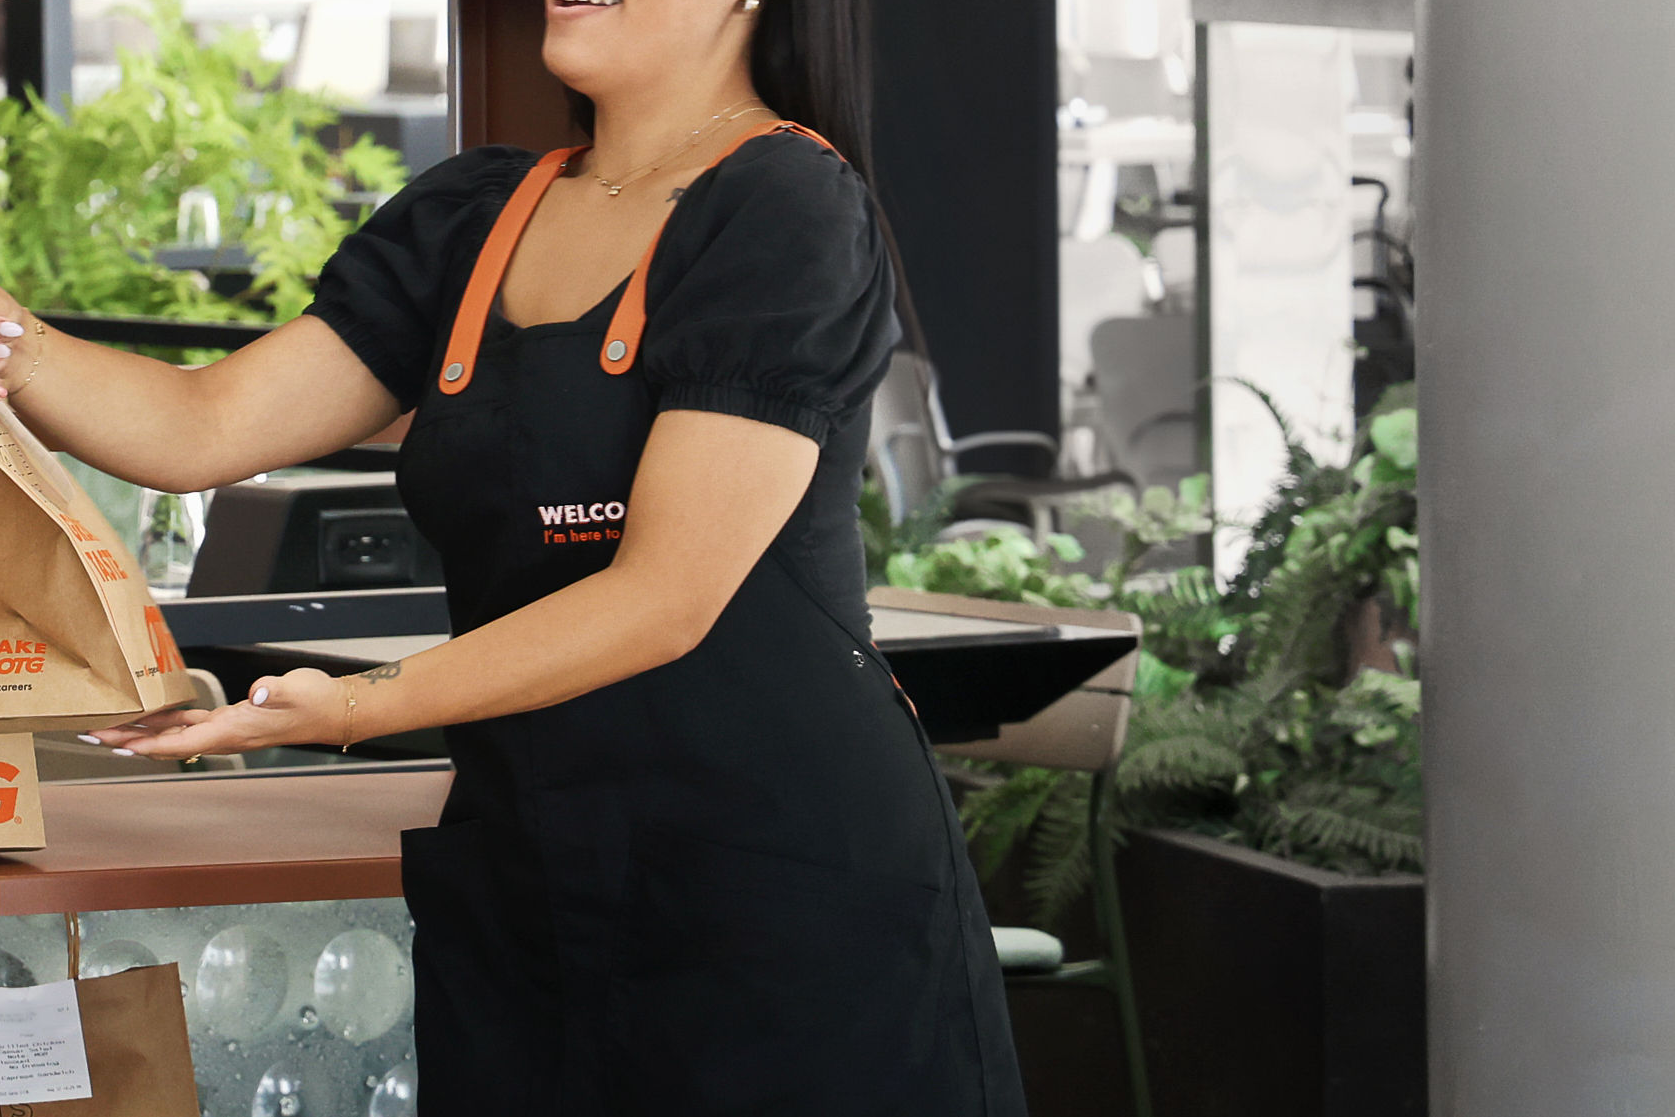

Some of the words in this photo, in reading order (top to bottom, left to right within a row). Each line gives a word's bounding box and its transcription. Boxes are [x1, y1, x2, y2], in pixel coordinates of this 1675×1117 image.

[538, 501, 625, 525] WELCO
[544, 529, 567, 544] I'm
[570, 529, 602, 542] here
[606, 528, 621, 539] to
